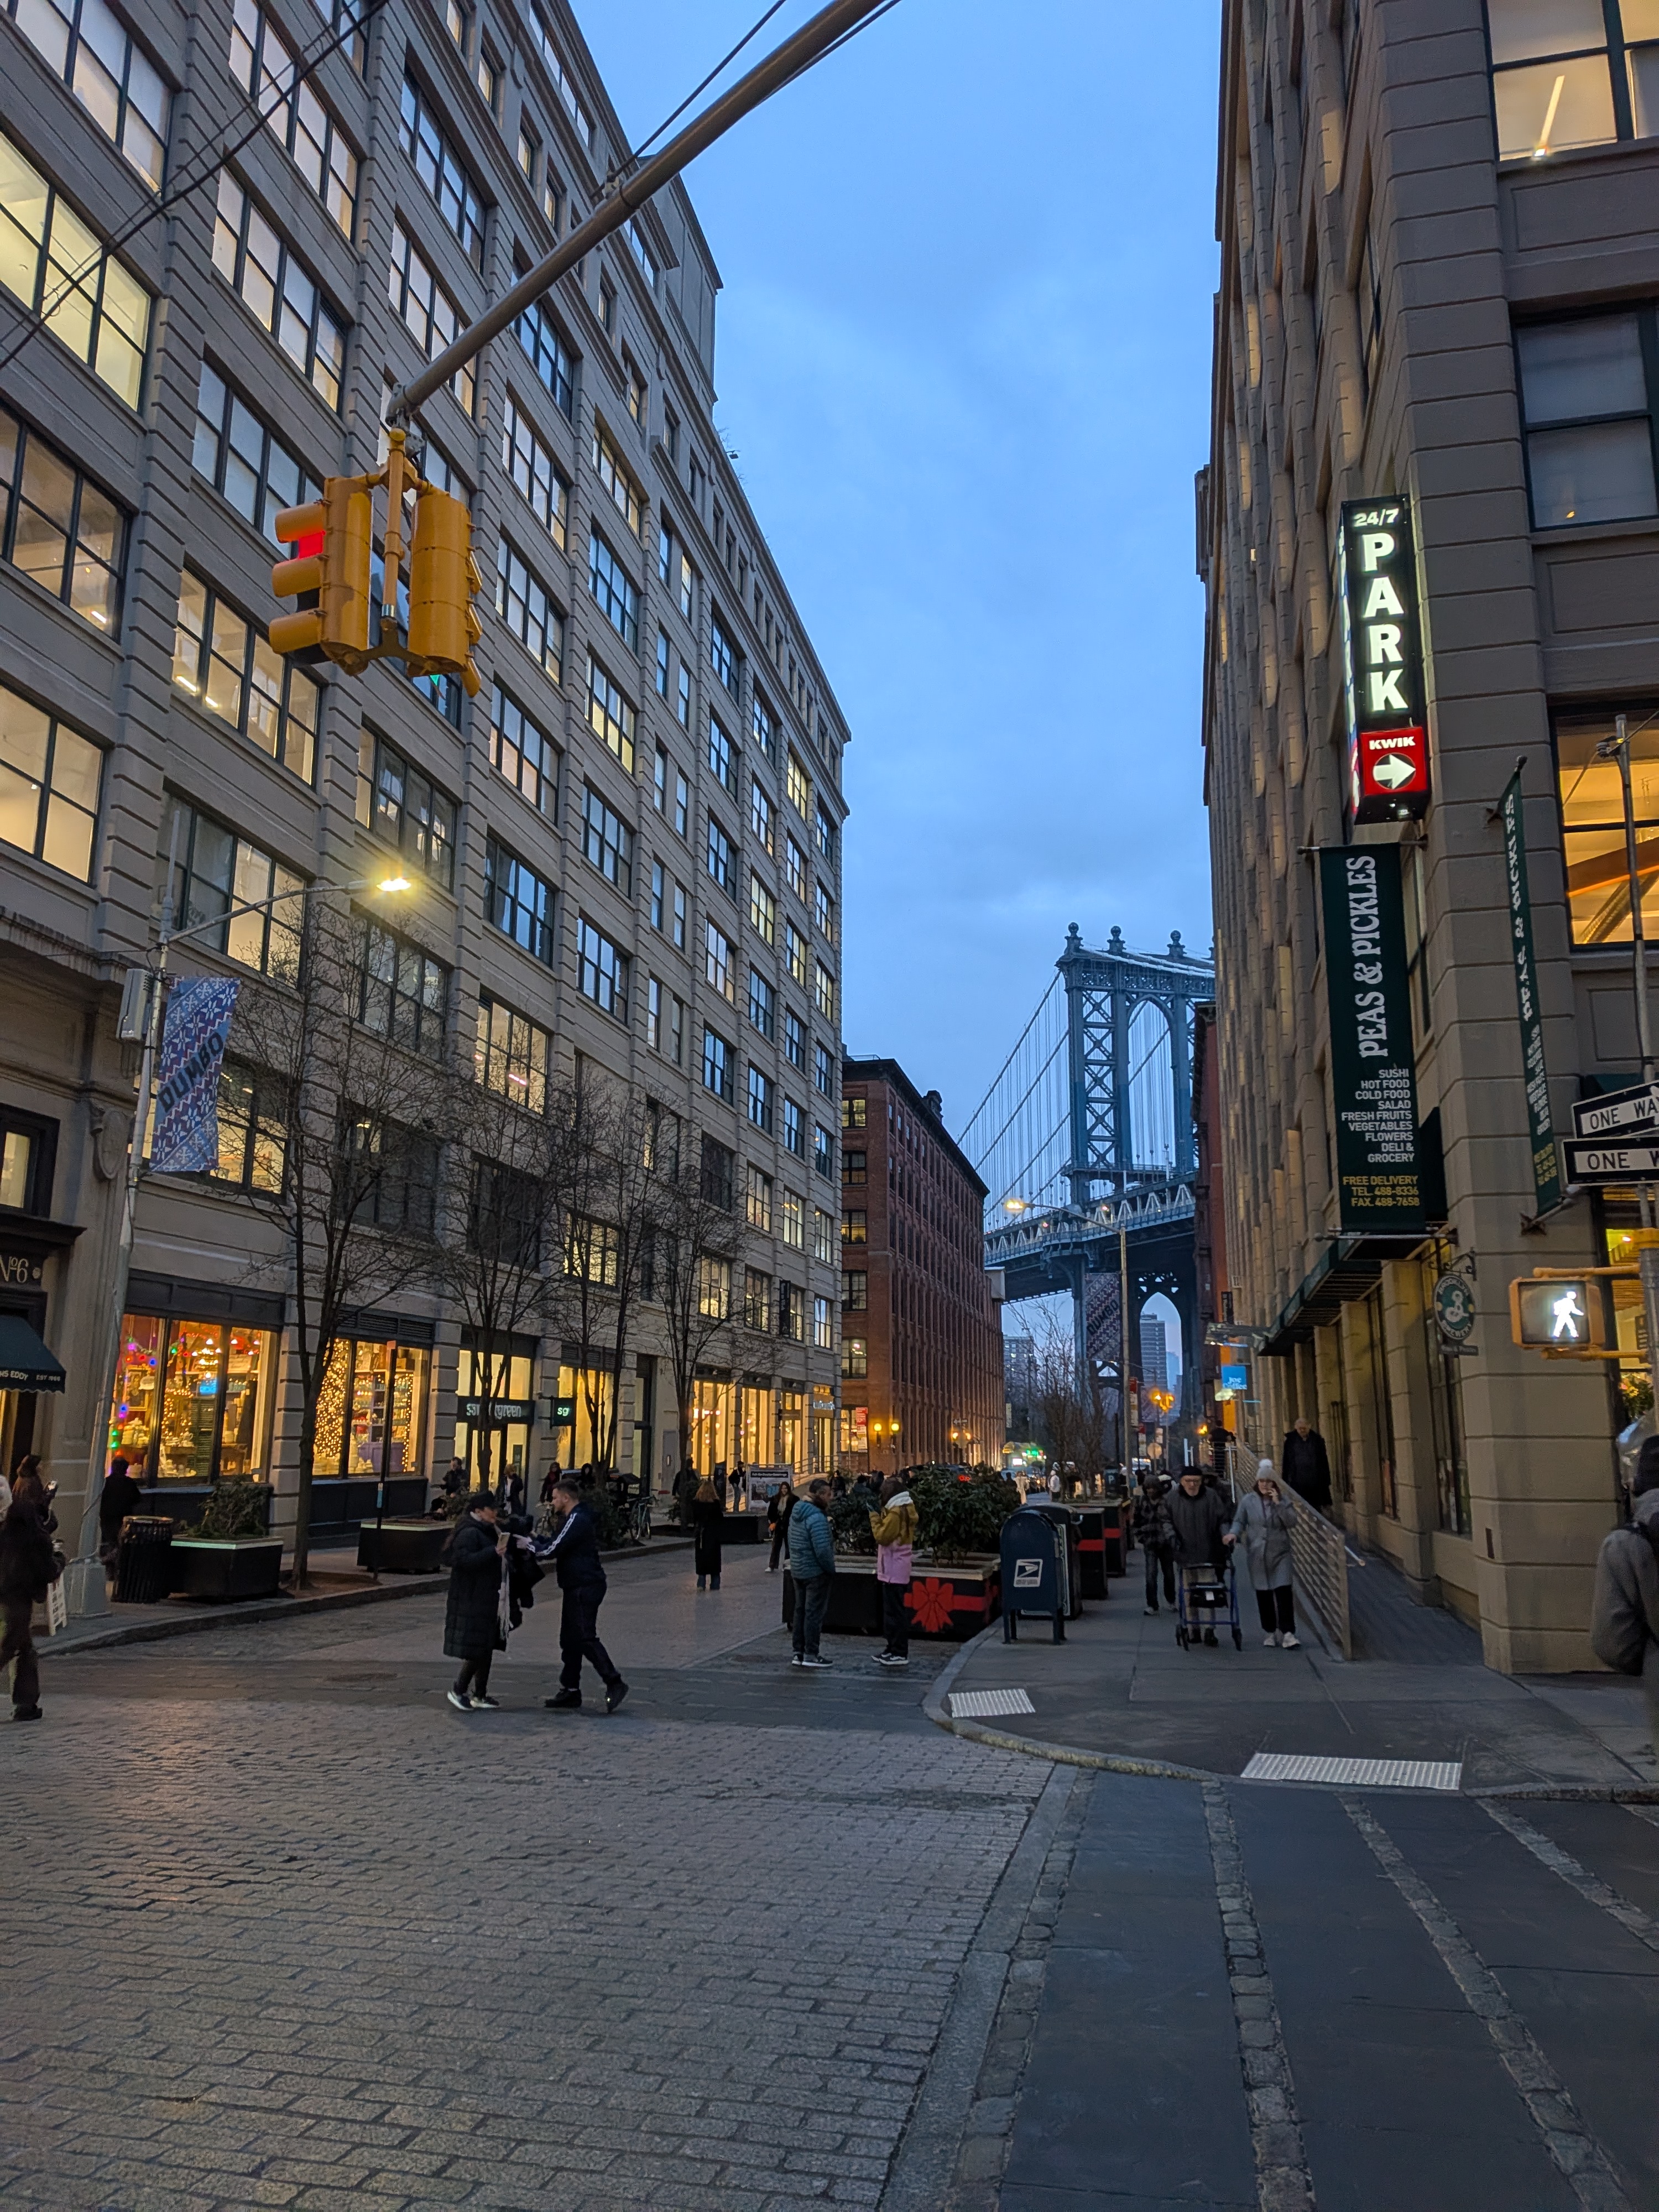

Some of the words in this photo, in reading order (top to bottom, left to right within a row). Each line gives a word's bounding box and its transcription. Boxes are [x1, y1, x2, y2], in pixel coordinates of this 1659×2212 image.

[1354, 508, 1399, 527] 24/7
[1362, 533, 1408, 711] PARK
[1369, 736, 1416, 750] KWIK
[1346, 856, 1381, 956] PICKLES
[1353, 962, 1383, 984] &
[1355, 992, 1388, 1058] PEAS
[158, 1032, 223, 1113] DUMBO
[1379, 1068, 1409, 1078] SUSHI
[1361, 1080, 1381, 1089] HOT
[1383, 1079, 1410, 1088] FOOD
[1355, 1091, 1381, 1099] COLD
[1384, 1090, 1410, 1099] FOOD
[1378, 1100, 1411, 1109] SALAD
[1342, 1112, 1374, 1121] FRESH
[1376, 1110, 1412, 1120] FRUITS
[1590, 1107, 1620, 1129] ONE
[1634, 1097, 1659, 1118] WA
[1348, 1121, 1412, 1131] VEGETABLES
[1365, 1132, 1413, 1141] FLOWERS
[1381, 1142, 1404, 1151] DELI
[1406, 1142, 1414, 1151] &
[1368, 1153, 1415, 1162] GROCERY
[1588, 1152, 1630, 1170] ONE
[1343, 1176, 1369, 1185] FREE
[1370, 1175, 1418, 1185] DELIVERY
[1087, 1300, 1118, 1335] DUMBO
[10, 1370, 28, 1381] EDDY
[1227, 1376, 1241, 1385] joe
[557, 1407, 570, 1416] sg
